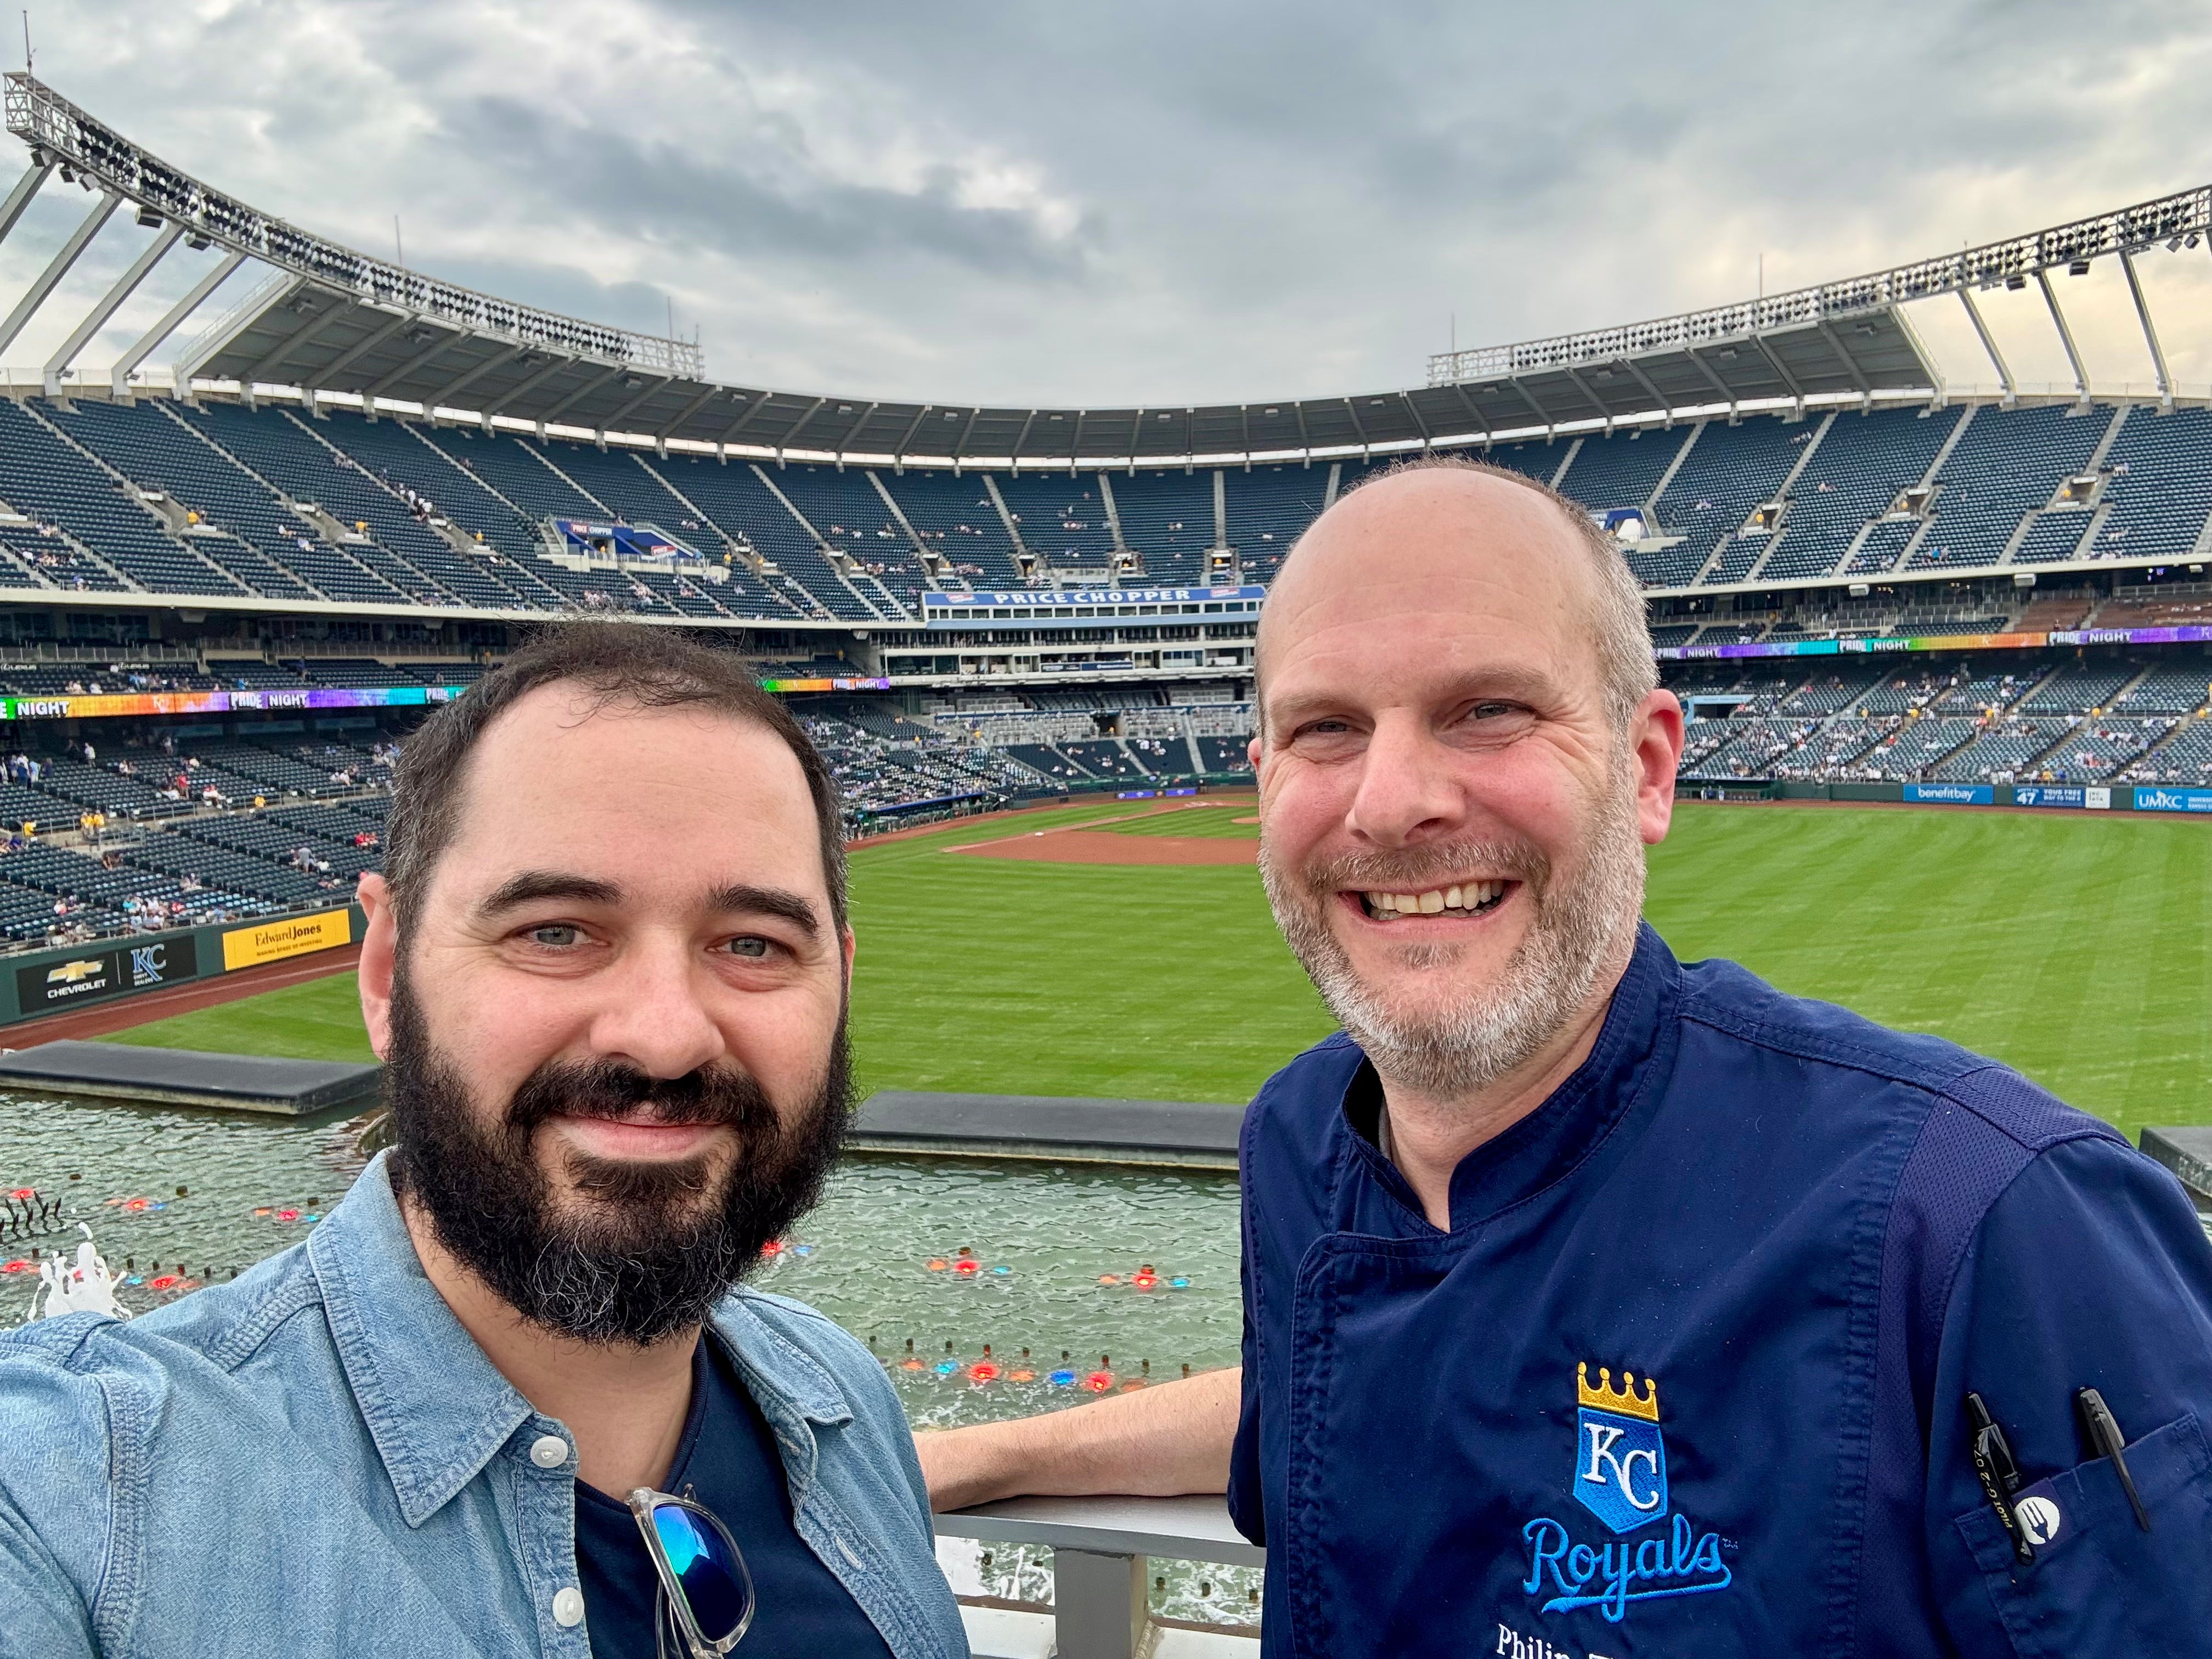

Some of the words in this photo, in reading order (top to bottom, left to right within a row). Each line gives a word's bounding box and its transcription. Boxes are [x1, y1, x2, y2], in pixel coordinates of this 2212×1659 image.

[994, 594, 1068, 603] PRICE
[1073, 590, 1190, 603] CHOPPER
[1874, 640, 1910, 651] NIGHT
[2089, 631, 2132, 643] NIGHT
[1687, 648, 1719, 658] NIGHT
[17, 700, 70, 716] NIGHT
[230, 691, 262, 710] PRIDE
[269, 693, 307, 708] NIGHT
[1918, 786, 1973, 803] benefitbay
[2017, 792, 2036, 805] 47
[2138, 793, 2182, 809] UMKC
[130, 943, 167, 982] KC
[47, 978, 106, 999] CHEVROLET
[1581, 1422, 1660, 1510] KC
[1980, 1471, 1997, 1499] G-2
[1993, 1501, 2013, 1528] PILOT
[1522, 1513, 1732, 1624] Royals
